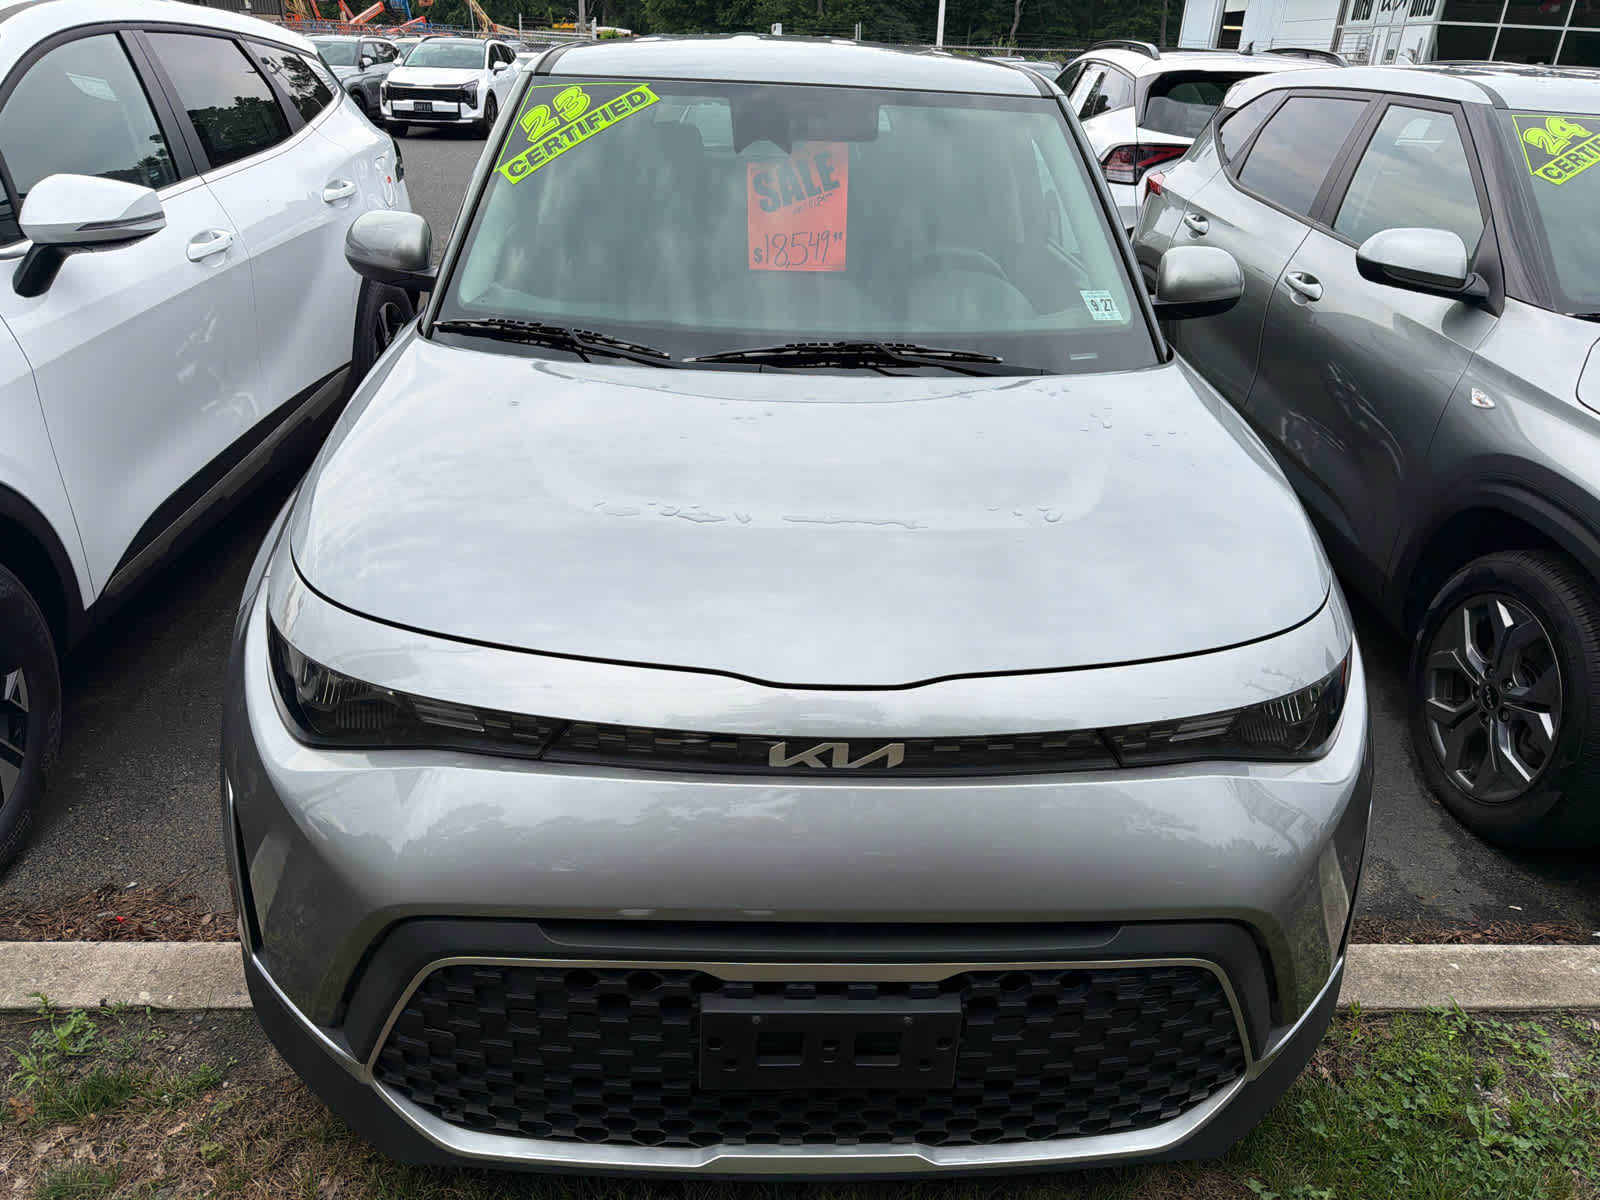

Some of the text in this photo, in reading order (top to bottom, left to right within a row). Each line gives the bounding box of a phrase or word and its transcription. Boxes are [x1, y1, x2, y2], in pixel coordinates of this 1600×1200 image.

[507, 90, 651, 178] CERTIFIED
[520, 86, 591, 142] 23
[1523, 117, 1593, 156] 24
[752, 151, 841, 213] SALE
[769, 741, 905, 769] KIA
